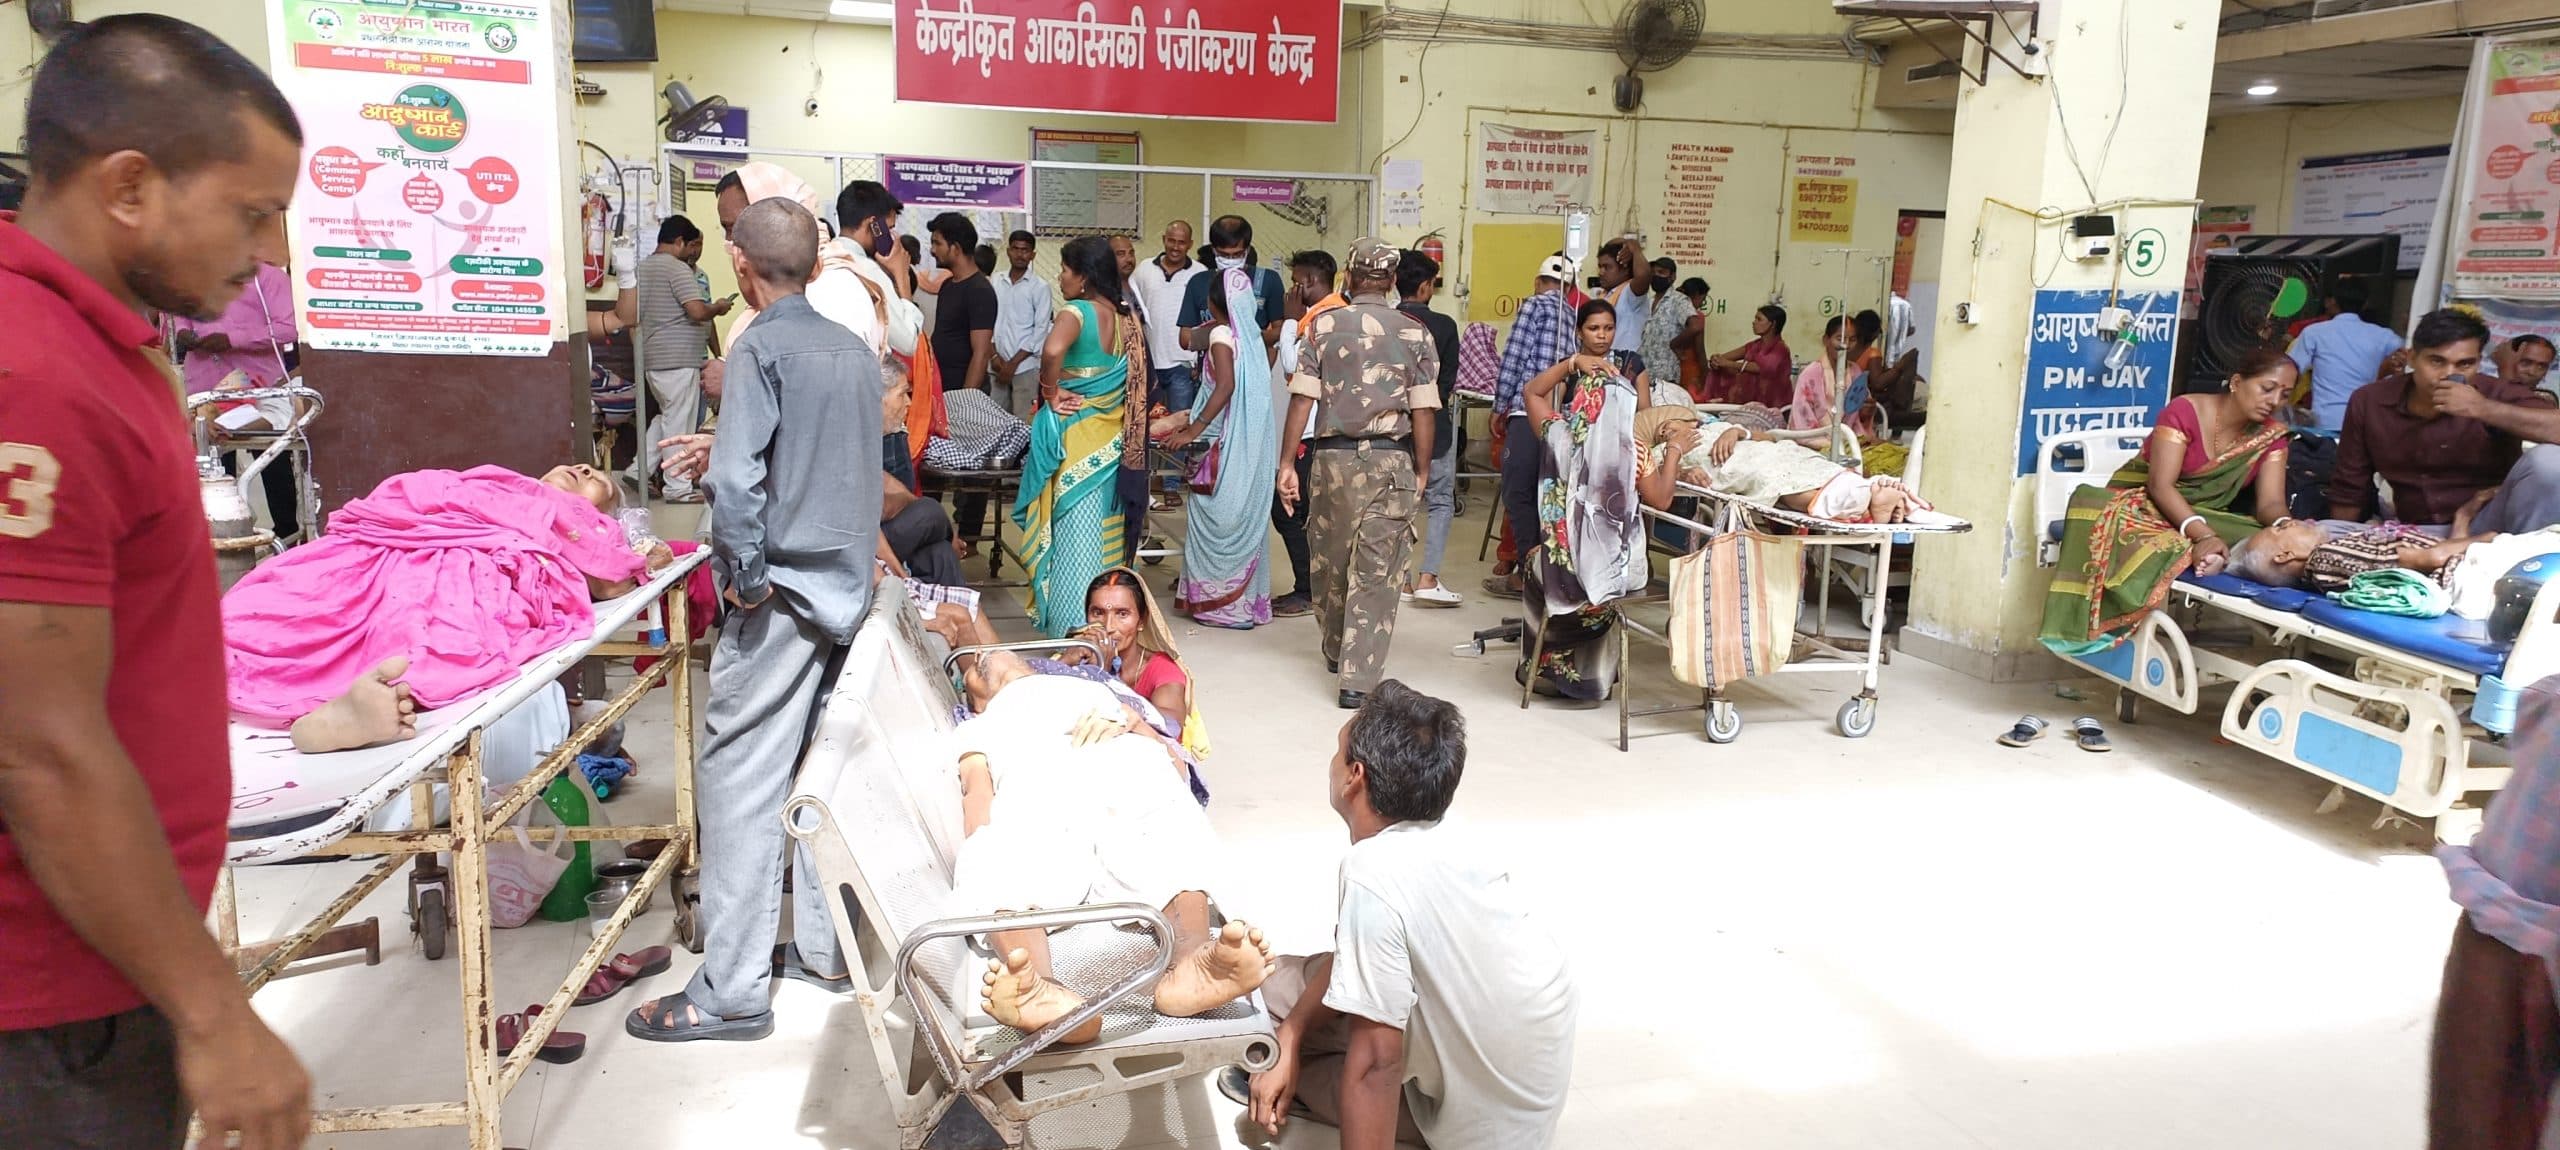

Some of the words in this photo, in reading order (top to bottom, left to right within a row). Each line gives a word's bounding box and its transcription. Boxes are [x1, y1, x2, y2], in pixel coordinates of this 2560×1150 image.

[359, 14, 424, 32] आयुष्मान
[432, 19, 470, 33] भारत
[915, 0, 1015, 78] केन्द्रीकृत
[1024, 1, 1147, 70] आकस्मिकी
[1155, 7, 1257, 76] पंजीकरण
[1268, 15, 1316, 85] केन्द्र
[423, 54, 429, 63] 5
[431, 54, 452, 65] लाख
[362, 104, 449, 126] आयुष्मान
[416, 120, 463, 138] कार्ड
[1671, 143, 1702, 152] HEALTH
[316, 166, 361, 175] (Common
[894, 162, 939, 173] अस्पताल
[942, 162, 973, 174] परिसर
[975, 164, 985, 174] में
[987, 166, 1014, 176] मास्क
[322, 175, 355, 184] Service
[900, 172, 915, 181] का
[918, 173, 952, 184] उपयोग
[322, 184, 357, 194] Centre)
[1236, 184, 1268, 196] Registration
[1269, 186, 1290, 196] Counter
[2135, 240, 2154, 268] 5
[1717, 299, 1726, 314] H
[1823, 299, 1832, 314] 3
[2101, 365, 2152, 389] JAY
[0, 442, 63, 538] 3
